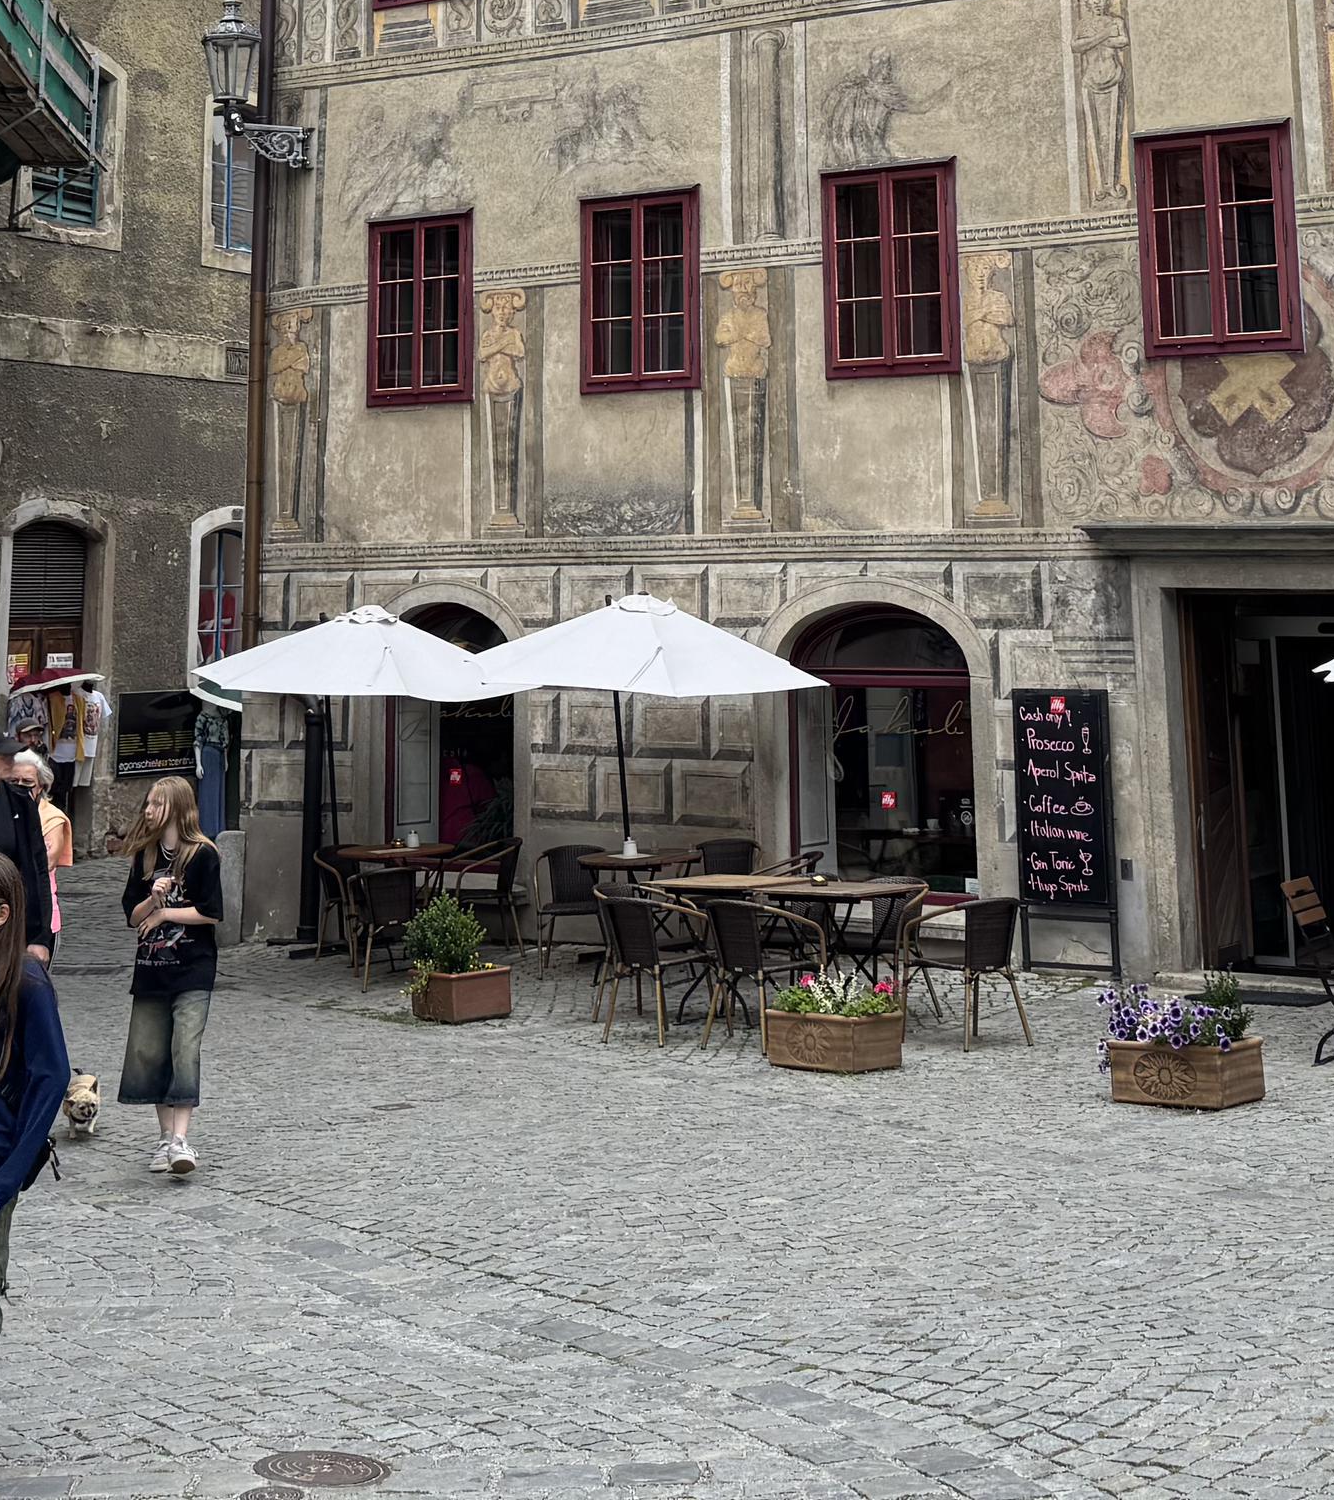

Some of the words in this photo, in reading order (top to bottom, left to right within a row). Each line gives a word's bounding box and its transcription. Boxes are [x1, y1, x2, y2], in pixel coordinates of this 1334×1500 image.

[1019, 706, 1043, 722] Cash
[1026, 727, 1075, 752] Prosecco
[1027, 758, 1059, 786] Aperol
[1028, 794, 1069, 815] Coffee
[1030, 819, 1065, 840] Italian
[1030, 851, 1048, 871] Gin
[1048, 851, 1076, 870] Tonic
[1030, 873, 1058, 900] Hugo
